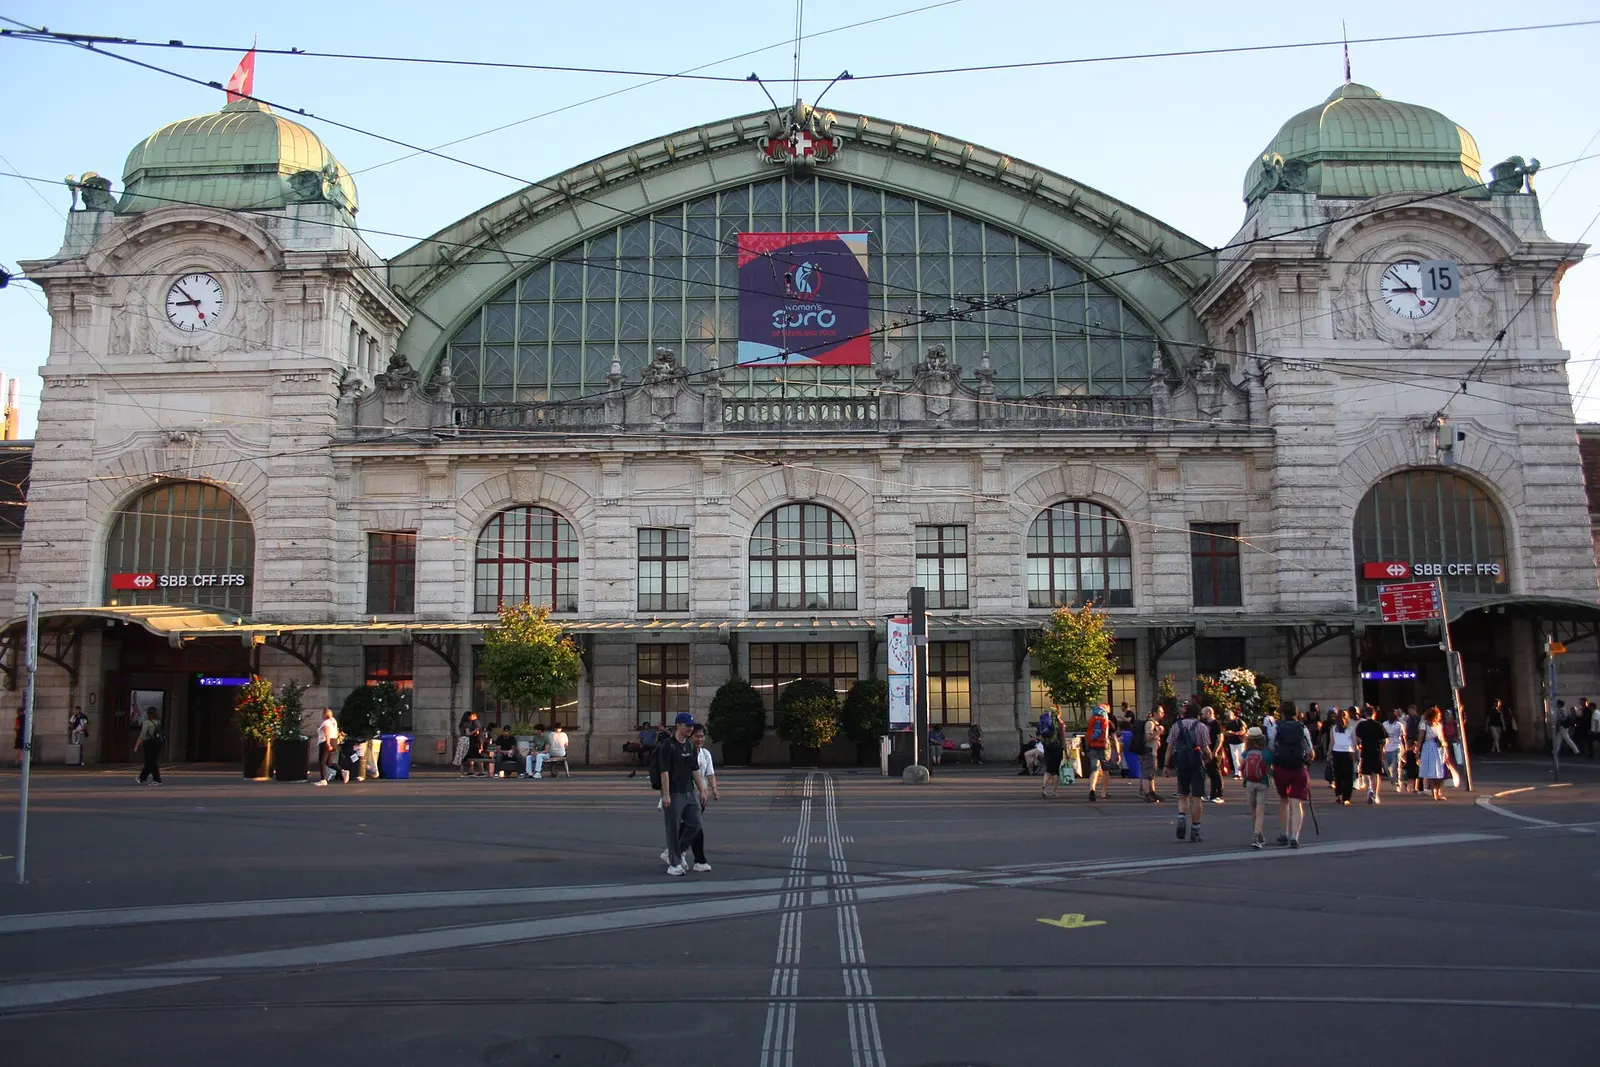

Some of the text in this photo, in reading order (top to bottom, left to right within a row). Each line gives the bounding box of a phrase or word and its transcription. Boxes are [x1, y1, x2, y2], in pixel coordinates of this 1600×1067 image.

[1428, 267, 1452, 291] 15
[1414, 563, 1500, 575] SBB CFF FFS
[160, 574, 245, 587] SBB CFF FFS
